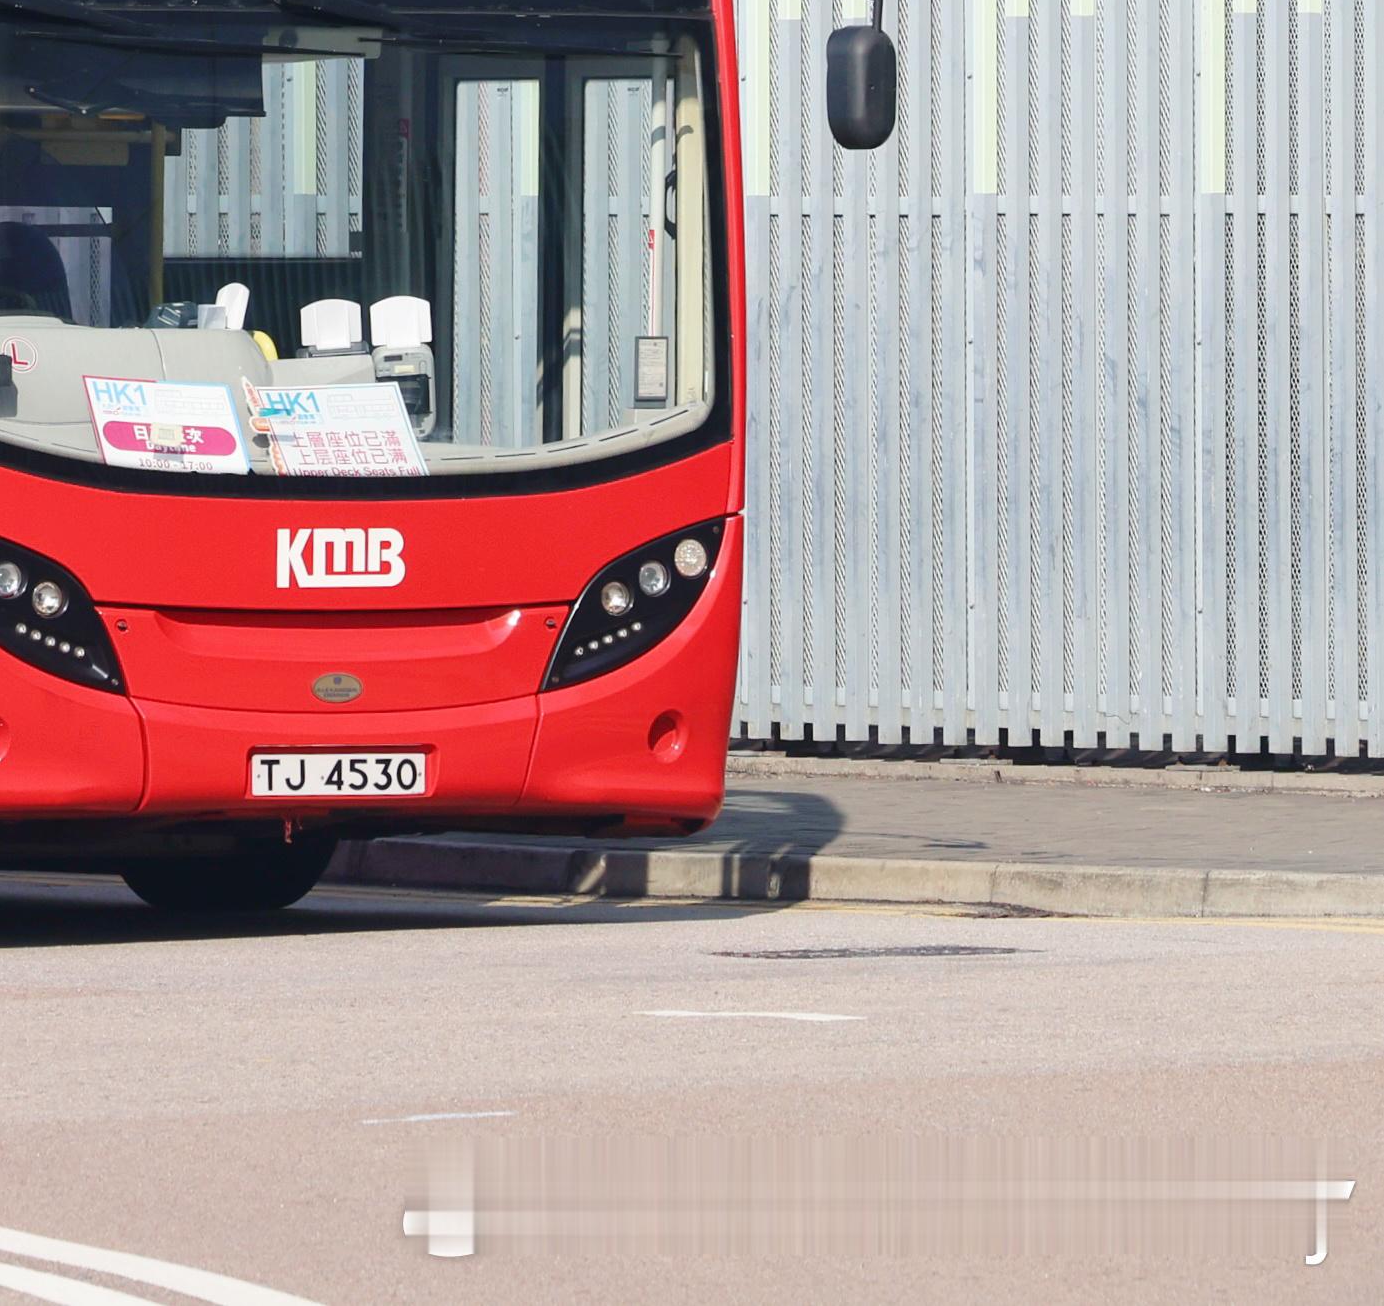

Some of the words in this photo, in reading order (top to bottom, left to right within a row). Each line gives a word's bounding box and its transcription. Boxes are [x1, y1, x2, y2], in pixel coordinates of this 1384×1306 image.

[92, 380, 148, 406] HK1
[265, 391, 320, 414] HK1
[133, 425, 205, 444] 日次
[139, 457, 170, 469] 10:00
[182, 460, 213, 470] 17:00
[331, 467, 359, 477] Deck
[363, 468, 393, 477] Seats
[398, 467, 420, 476] Full
[276, 527, 406, 589] KMB
[260, 758, 305, 791] TJ
[324, 758, 418, 791] 4530
